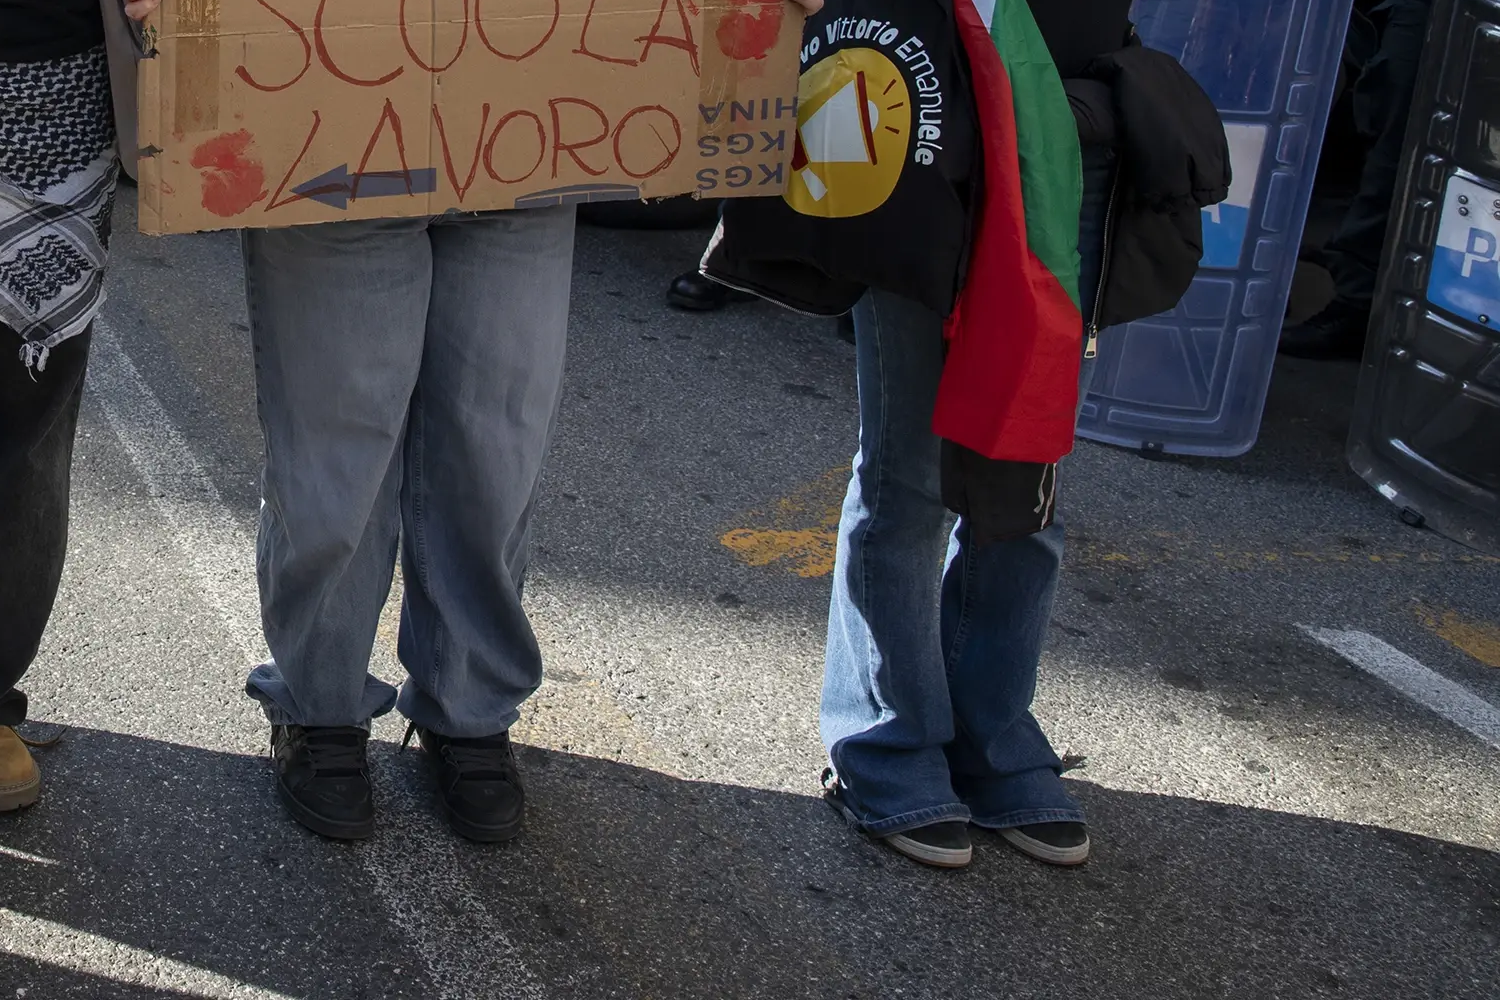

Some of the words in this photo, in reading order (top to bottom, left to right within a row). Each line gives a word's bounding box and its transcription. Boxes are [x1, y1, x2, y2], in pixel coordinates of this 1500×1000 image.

[826, 16, 899, 46] Vittorio
[894, 35, 943, 166] Emanuele
[265, 98, 682, 213] LAVORO
[695, 162, 784, 191] KGS
[697, 130, 786, 158] KGS
